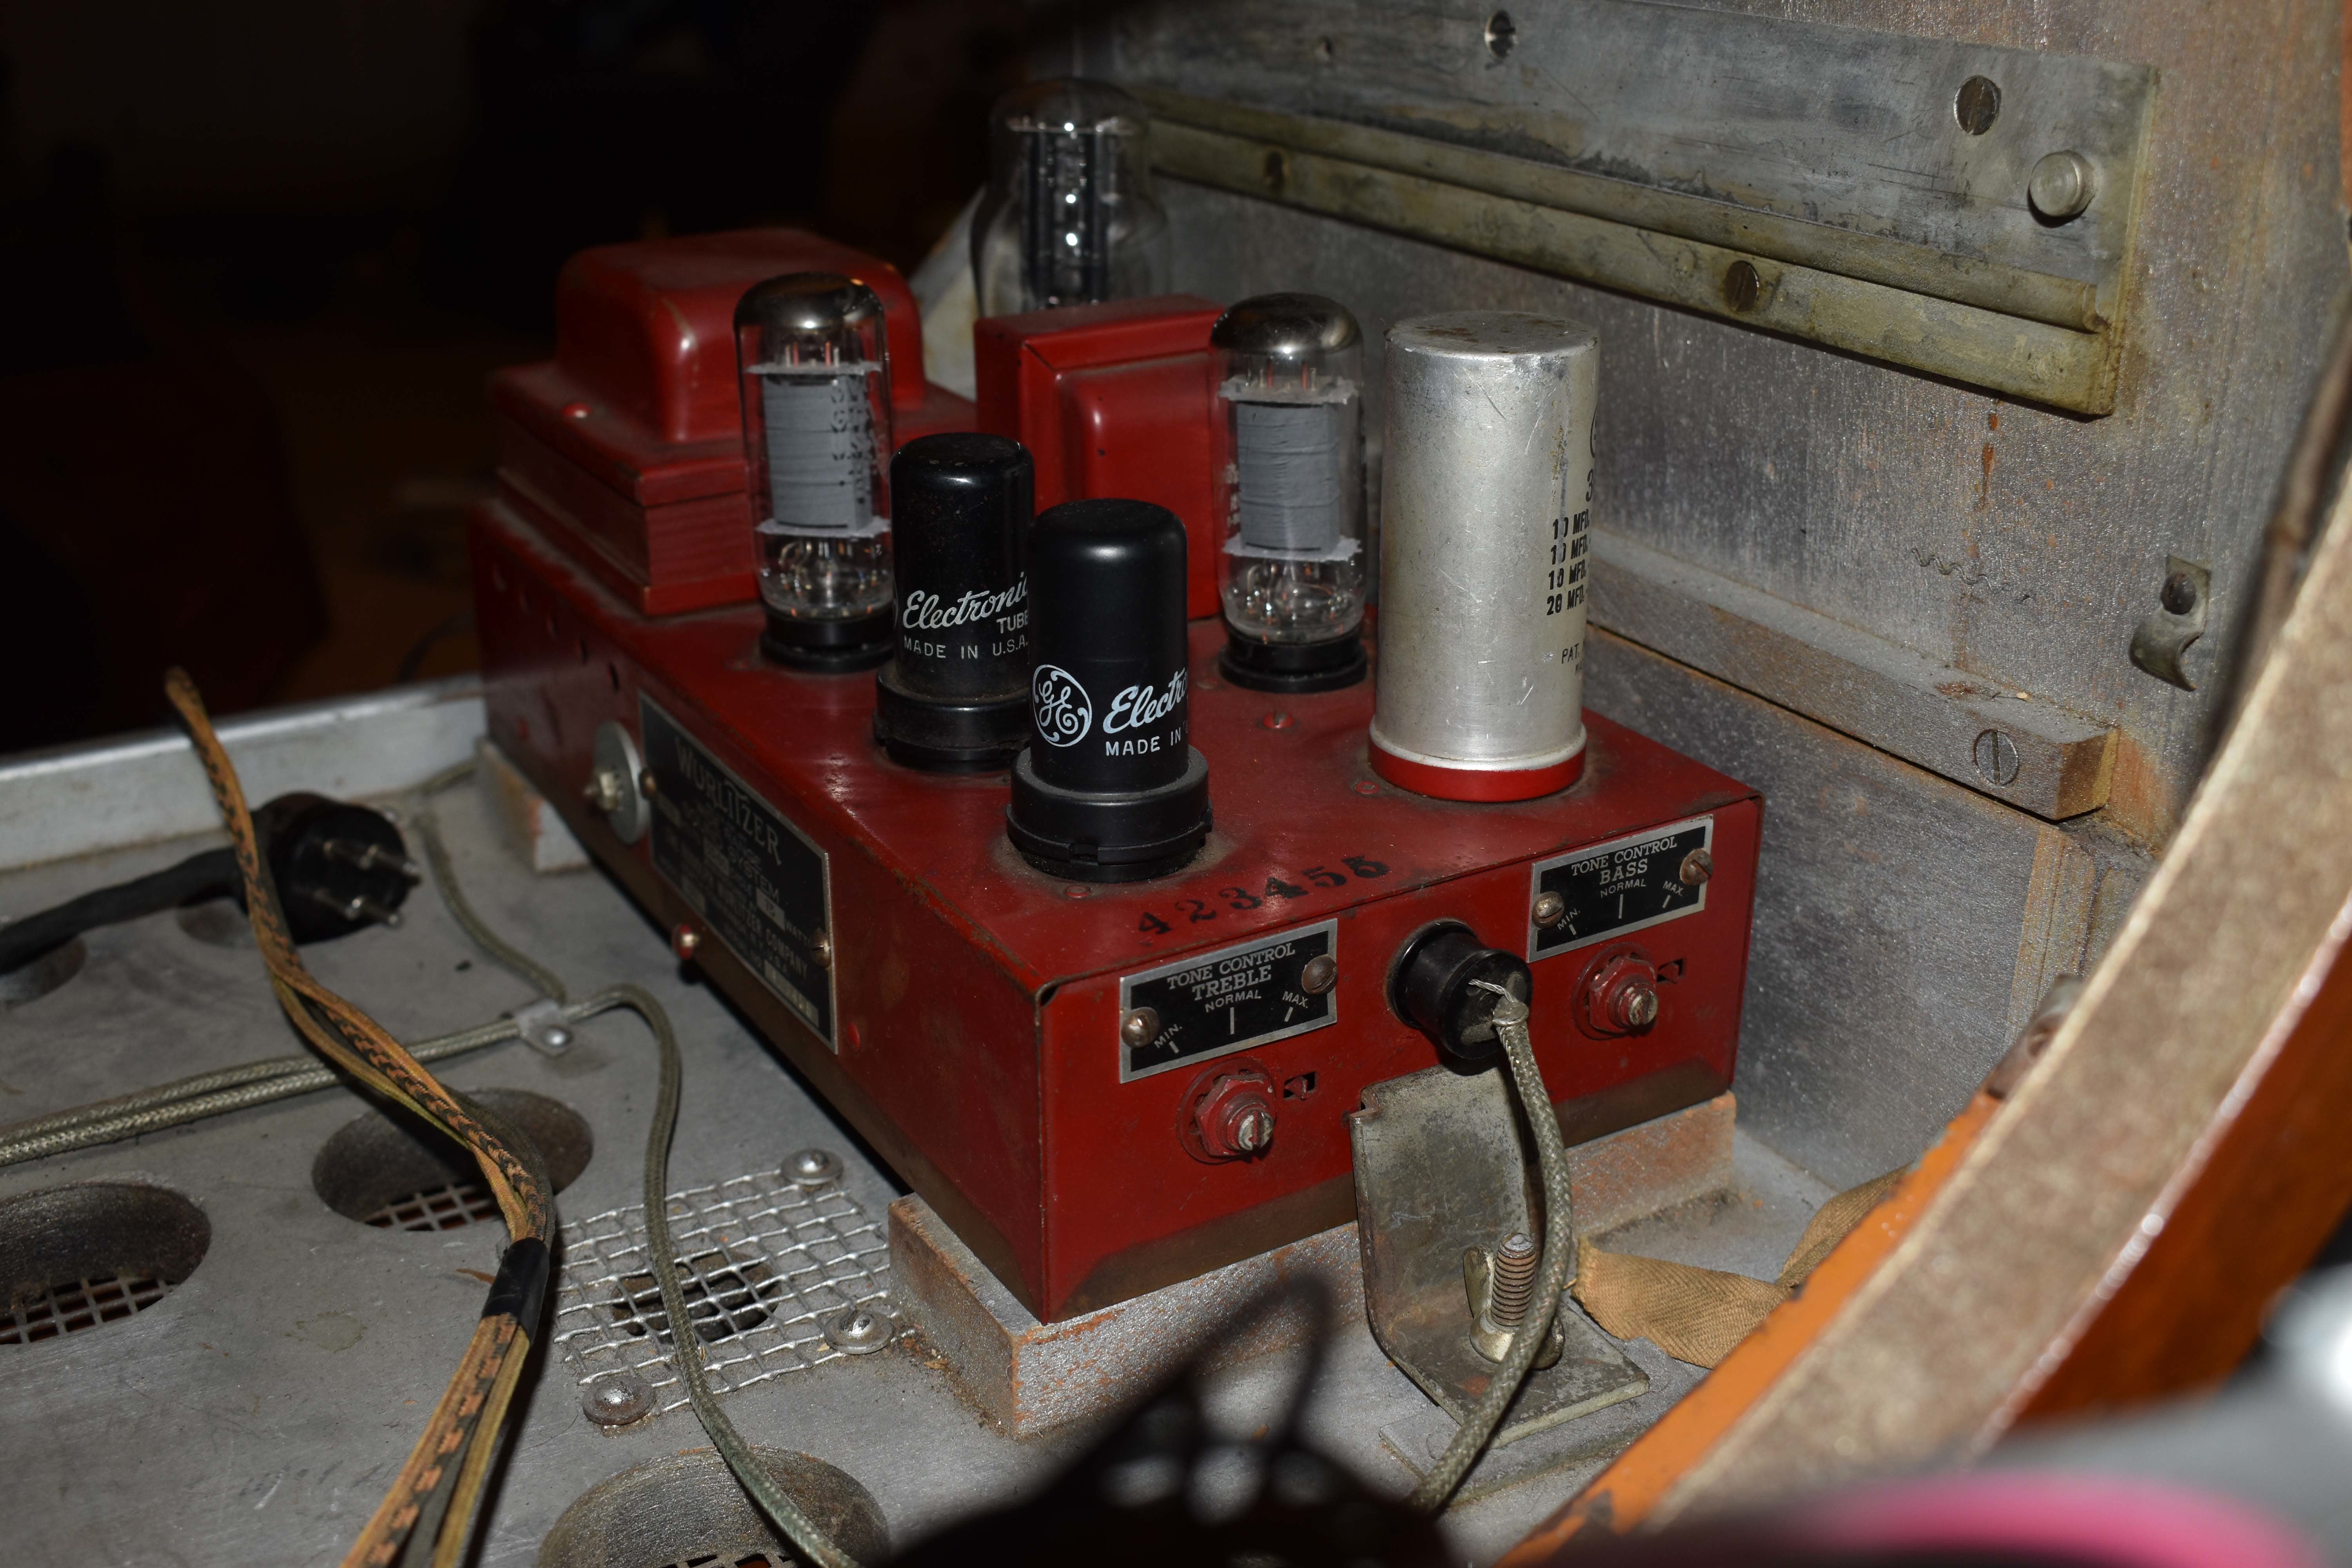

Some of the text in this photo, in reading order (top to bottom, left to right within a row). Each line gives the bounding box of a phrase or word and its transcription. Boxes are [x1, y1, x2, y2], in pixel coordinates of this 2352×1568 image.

[903, 635, 1028, 659] MADE IN U.S.A.
[1105, 736, 1160, 756] MADE
[1171, 727, 1181, 746] IN
[674, 736, 782, 866] WURLITZER
[1571, 836, 1677, 876] TONE CONTROL
[1599, 858, 1648, 885] BASS
[1600, 878, 1646, 898] NORMAL
[1662, 880, 1684, 897] MAX.
[1557, 908, 1581, 931] MIN.
[785, 919, 810, 948] WATT
[1167, 943, 1296, 991] TONE CONTROL
[1192, 965, 1272, 1001] TREBLE
[1204, 989, 1262, 1013] NORMAL
[1282, 991, 1309, 1009] MAX.
[1154, 1025, 1183, 1049] MIN.
